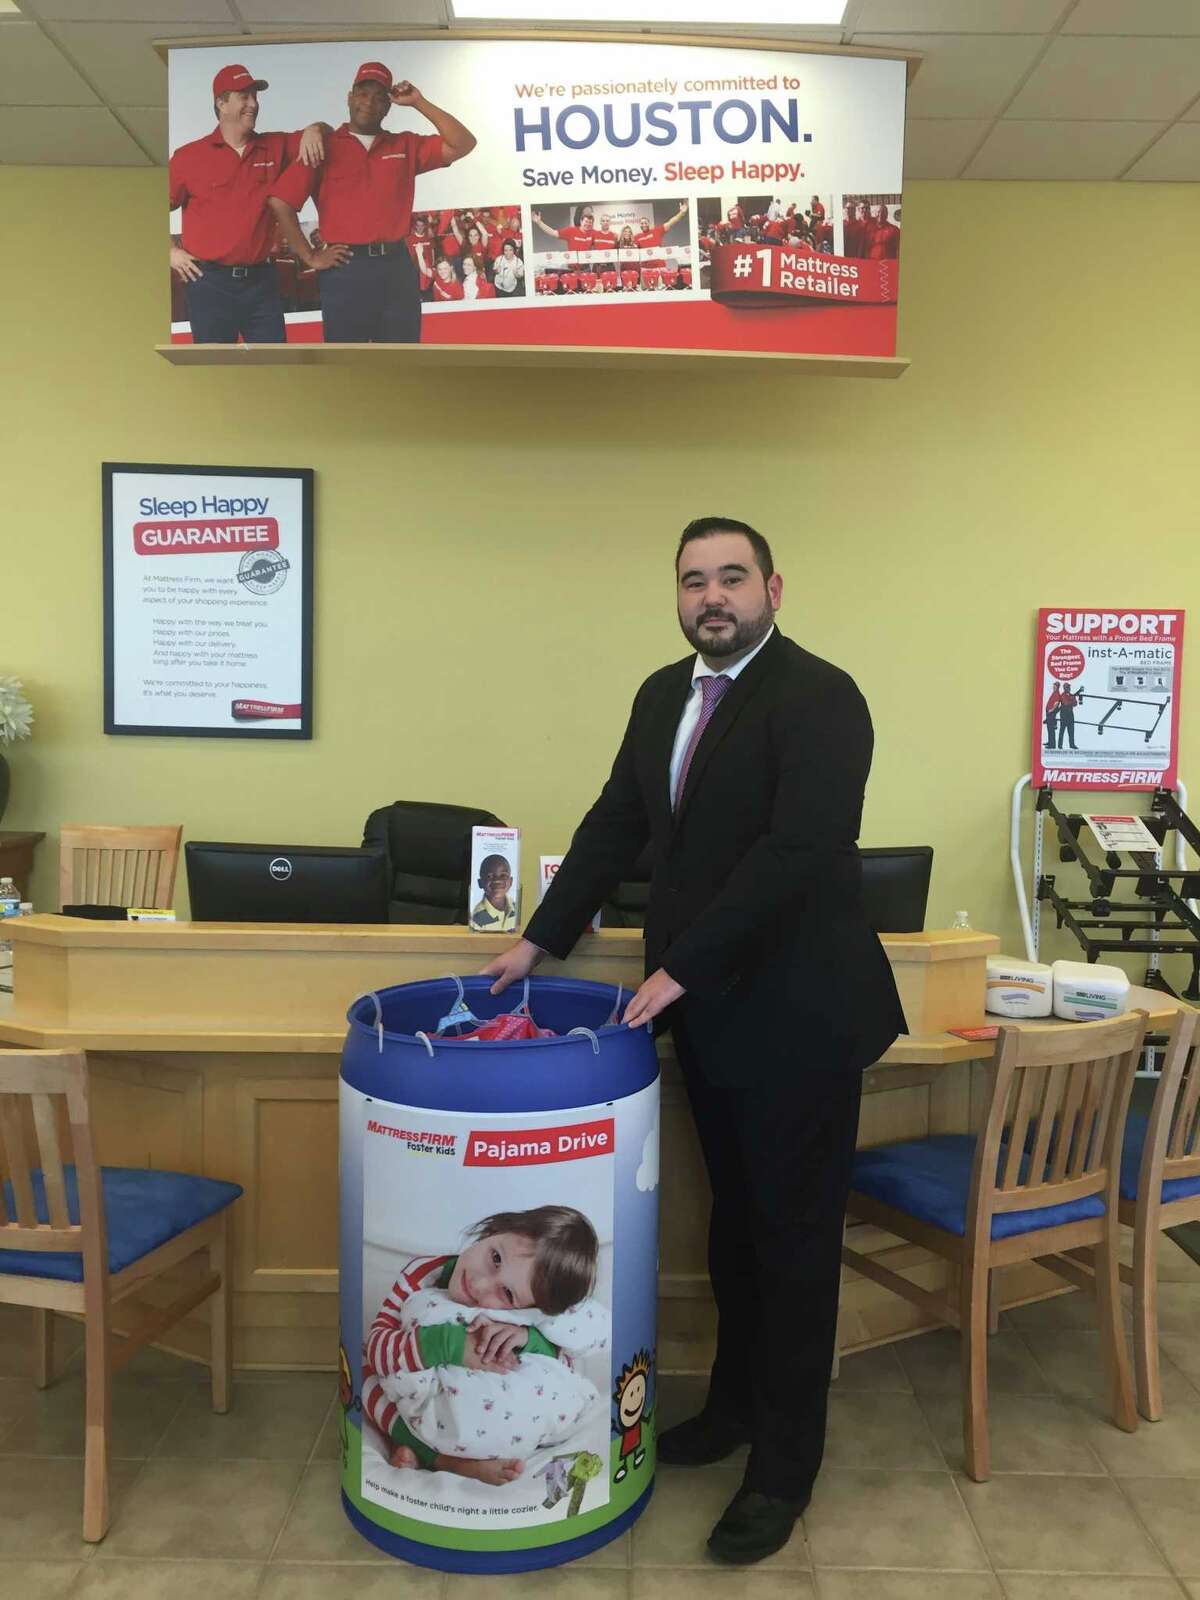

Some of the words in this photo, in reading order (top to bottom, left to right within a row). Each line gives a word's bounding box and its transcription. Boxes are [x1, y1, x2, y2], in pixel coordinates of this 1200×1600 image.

[515, 83, 565, 98] We're
[571, 78, 677, 98] passionately
[684, 76, 778, 92] committed
[783, 76, 800, 90] to
[514, 98, 812, 151] HOUSTON.
[522, 168, 573, 187] Save
[581, 165, 657, 186] Money.
[664, 162, 724, 185] Sleep
[731, 160, 805, 183] Happy.
[780, 253, 858, 278] Mattress
[780, 272, 859, 297] Retailer
[140, 497, 197, 517] Sleep
[202, 496, 270, 516] Happy
[141, 525, 270, 546] GUARANTEE
[1046, 613, 1177, 635] SUPPORT
[1088, 647, 1172, 659] inst-A-matic
[1043, 770, 1164, 784] MATTRESSFIRM
[367, 1120, 456, 1146] MATTRESSFIRM
[407, 1142, 434, 1153] Foster
[436, 1147, 456, 1156] Kids
[474, 1141, 551, 1161] Pajama
[558, 1132, 609, 1153] Drive
[365, 1479, 380, 1490] Help
[381, 1487, 399, 1498] make
[406, 1496, 428, 1507] foster
[429, 1502, 455, 1513] child's
[457, 1507, 479, 1516] night
[511, 1505, 538, 1514] cozier.
